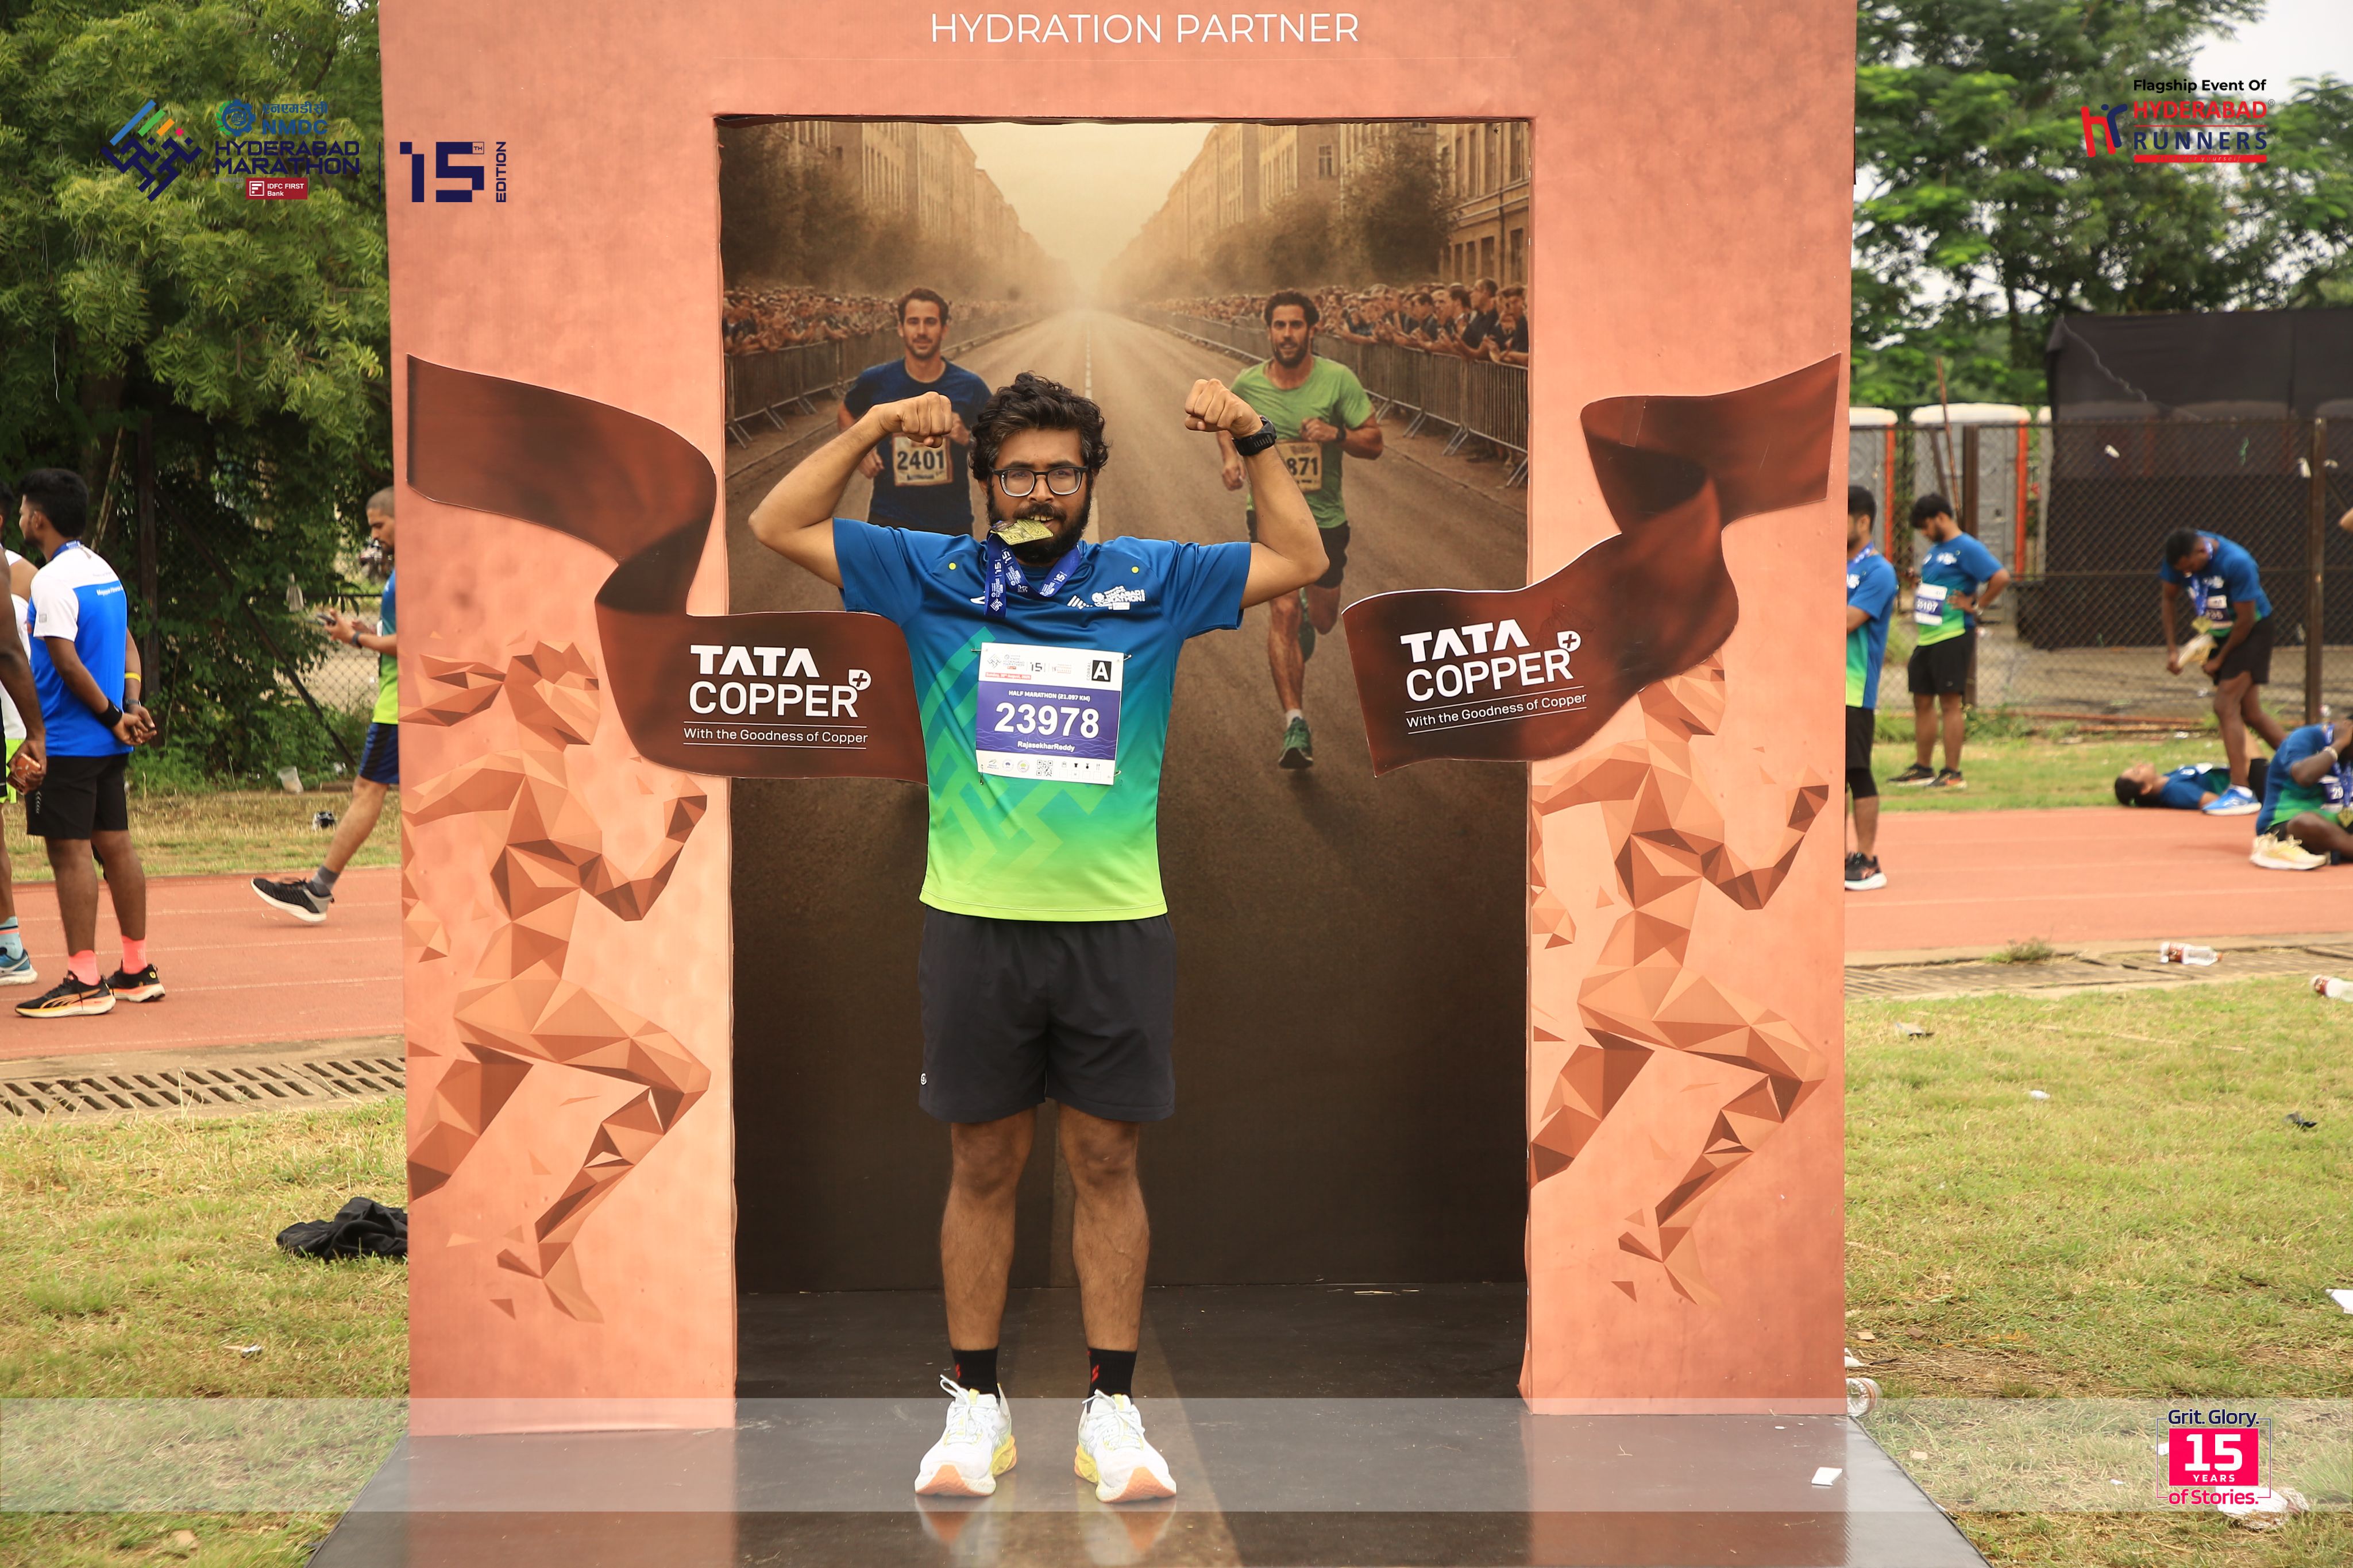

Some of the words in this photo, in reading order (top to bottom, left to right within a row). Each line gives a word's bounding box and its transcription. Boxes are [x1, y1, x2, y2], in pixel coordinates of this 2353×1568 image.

[931, 13, 1162, 44] HYDRATION
[1177, 13, 1359, 43] PARTNER
[897, 450, 944, 470] 2401
[1400, 619, 1530, 663] TATA
[690, 644, 820, 678] TATA
[1093, 661, 1109, 681] A
[1406, 648, 1574, 702] COPPER
[689, 681, 859, 718] COPPER
[1024, 691, 1057, 699] MARATHON
[1406, 712, 1436, 728] With
[1438, 711, 1459, 724] the
[1461, 704, 1524, 720] Goodness
[1526, 698, 1538, 711] of
[1541, 694, 1587, 709] Copper
[684, 727, 713, 740] With
[716, 728, 737, 740] the
[740, 729, 804, 741] Goodness
[806, 731, 819, 742] of
[821, 731, 869, 745] Copper
[994, 702, 1100, 739] 23978
[1017, 740, 1075, 752] RajasekharReddy
